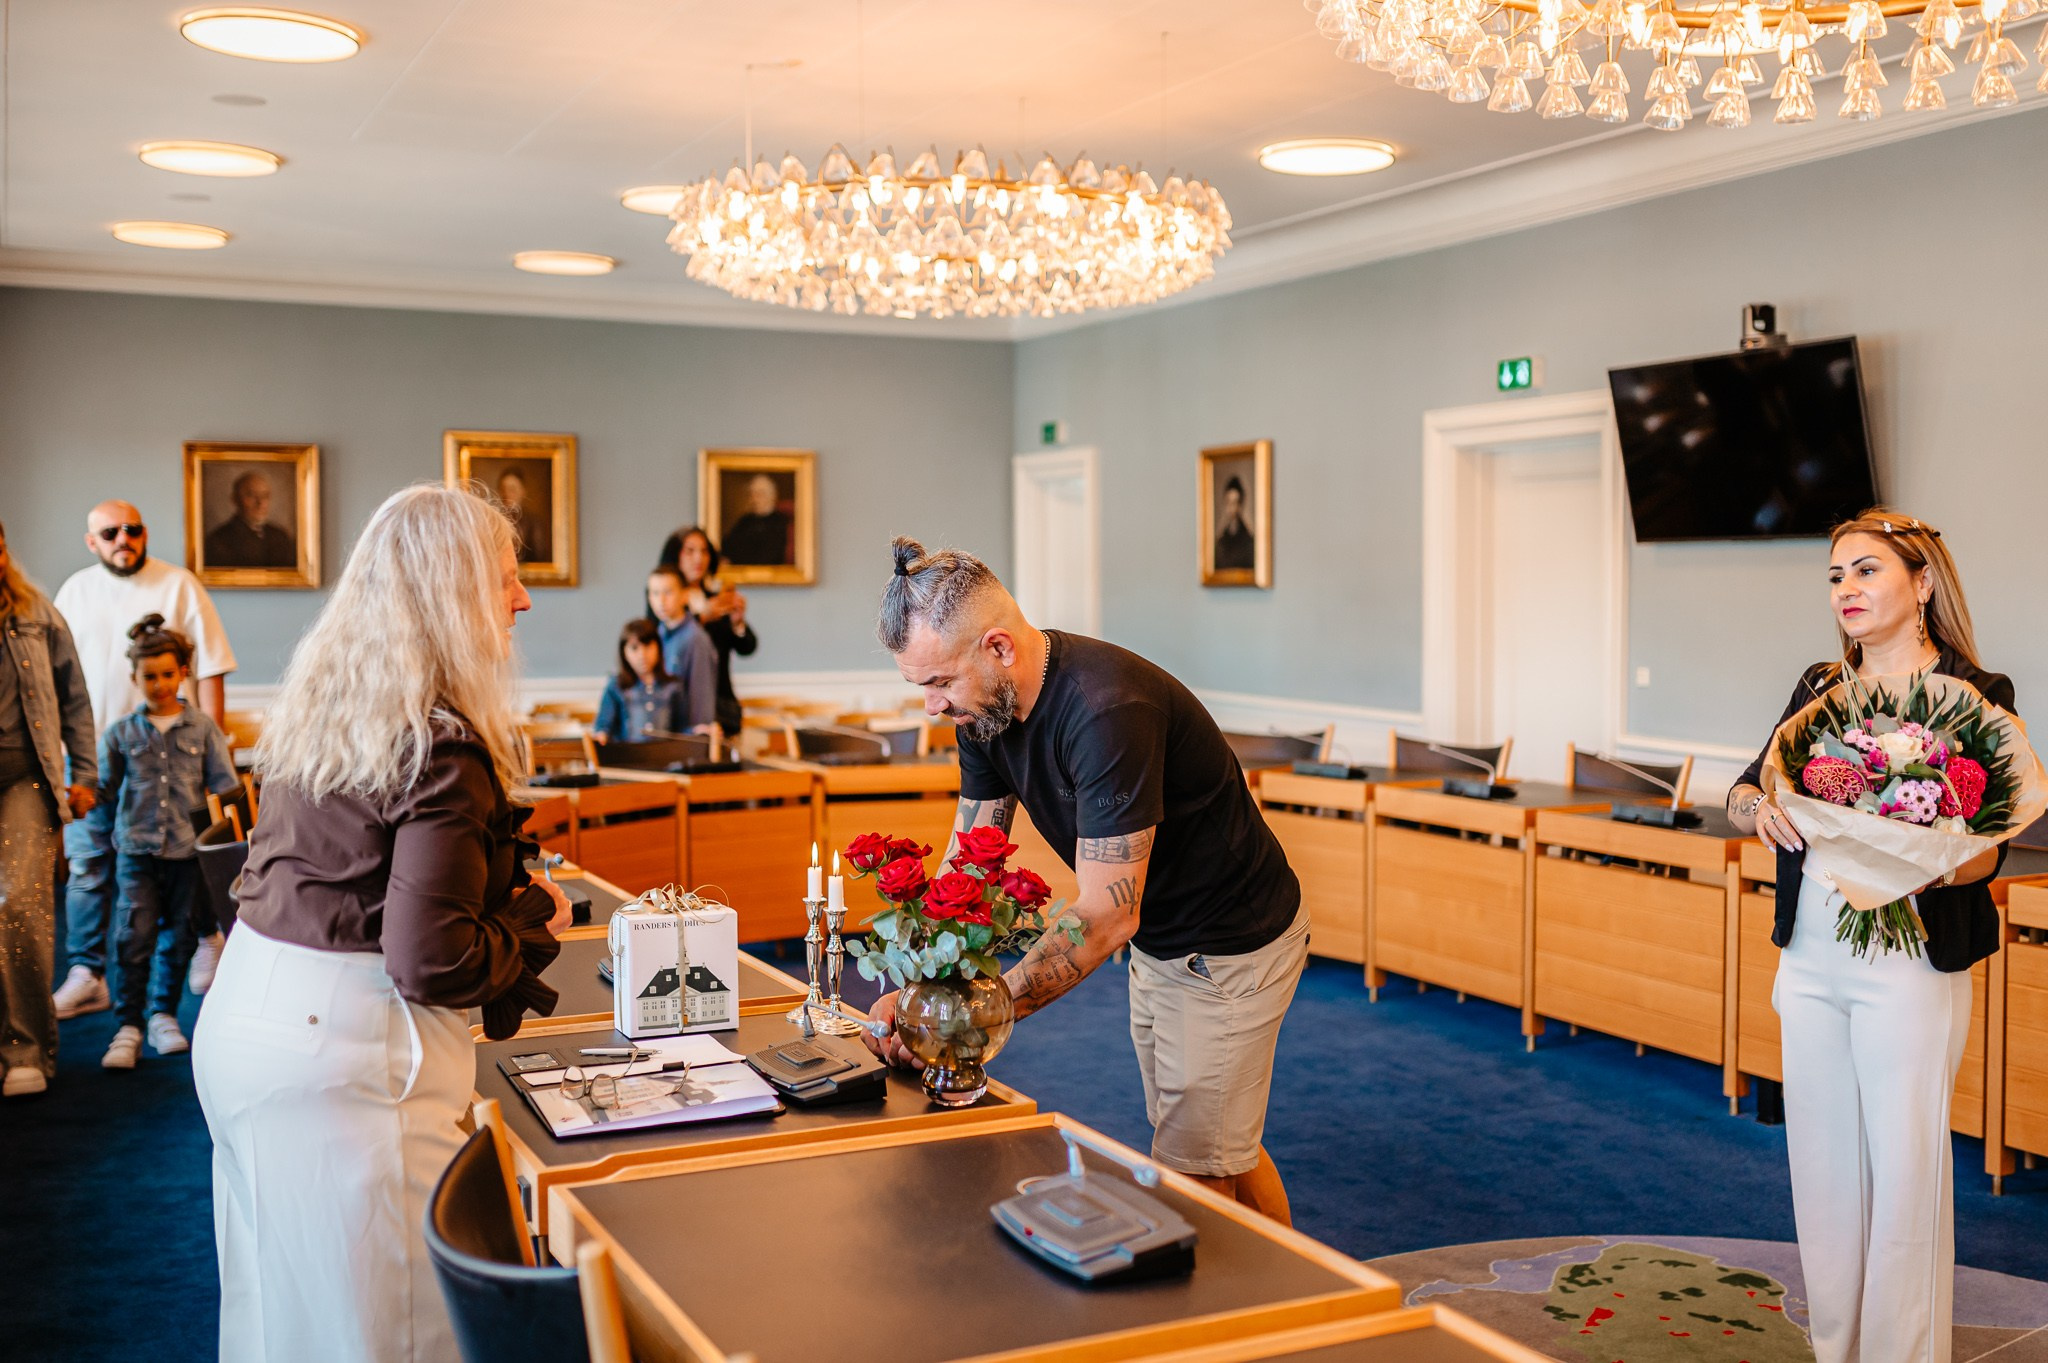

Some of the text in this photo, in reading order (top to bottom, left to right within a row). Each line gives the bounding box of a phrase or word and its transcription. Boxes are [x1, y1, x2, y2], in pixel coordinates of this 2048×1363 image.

[1098, 792, 1130, 808] BOSS
[634, 919, 706, 931] RANDERS RDHUS
